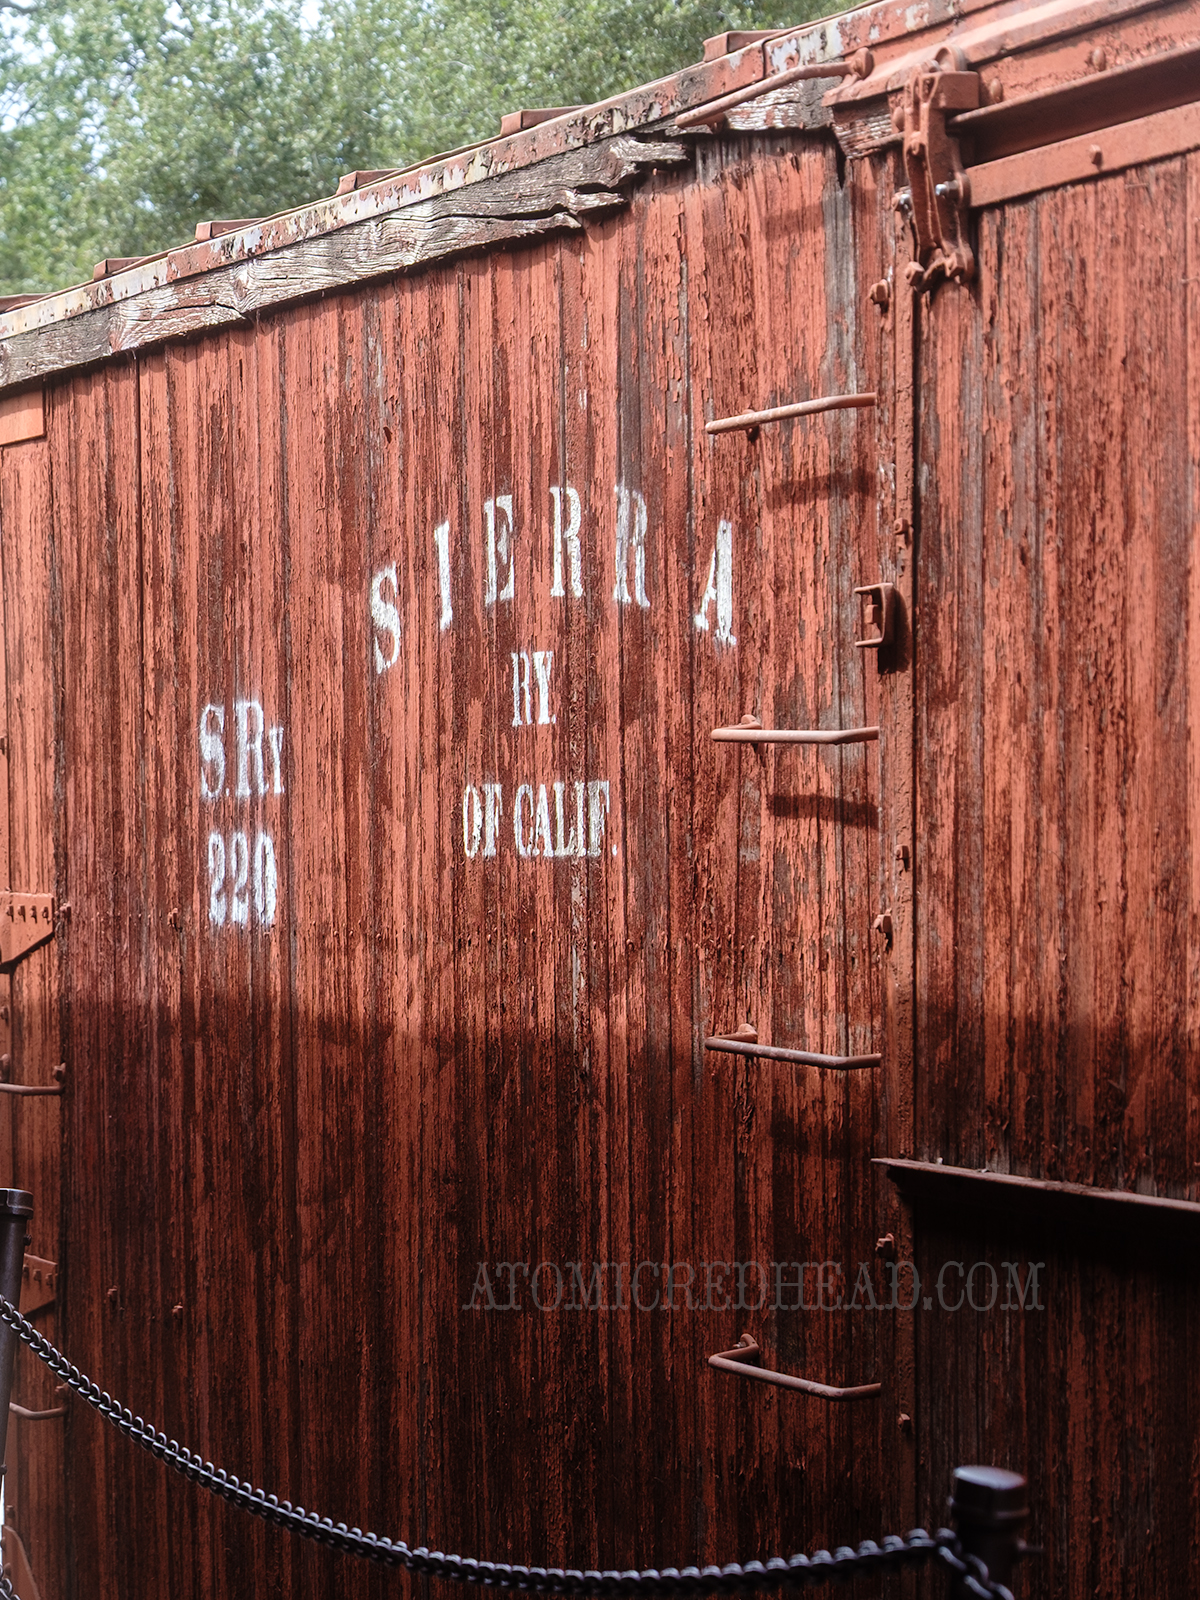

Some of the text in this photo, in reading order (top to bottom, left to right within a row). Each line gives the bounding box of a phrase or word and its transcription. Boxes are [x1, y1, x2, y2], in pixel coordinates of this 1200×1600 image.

[371, 484, 737, 675] SIERRA
[510, 650, 557, 727] RY.
[462, 780, 618, 858] OF CALIF.
[208, 832, 277, 927] 220
